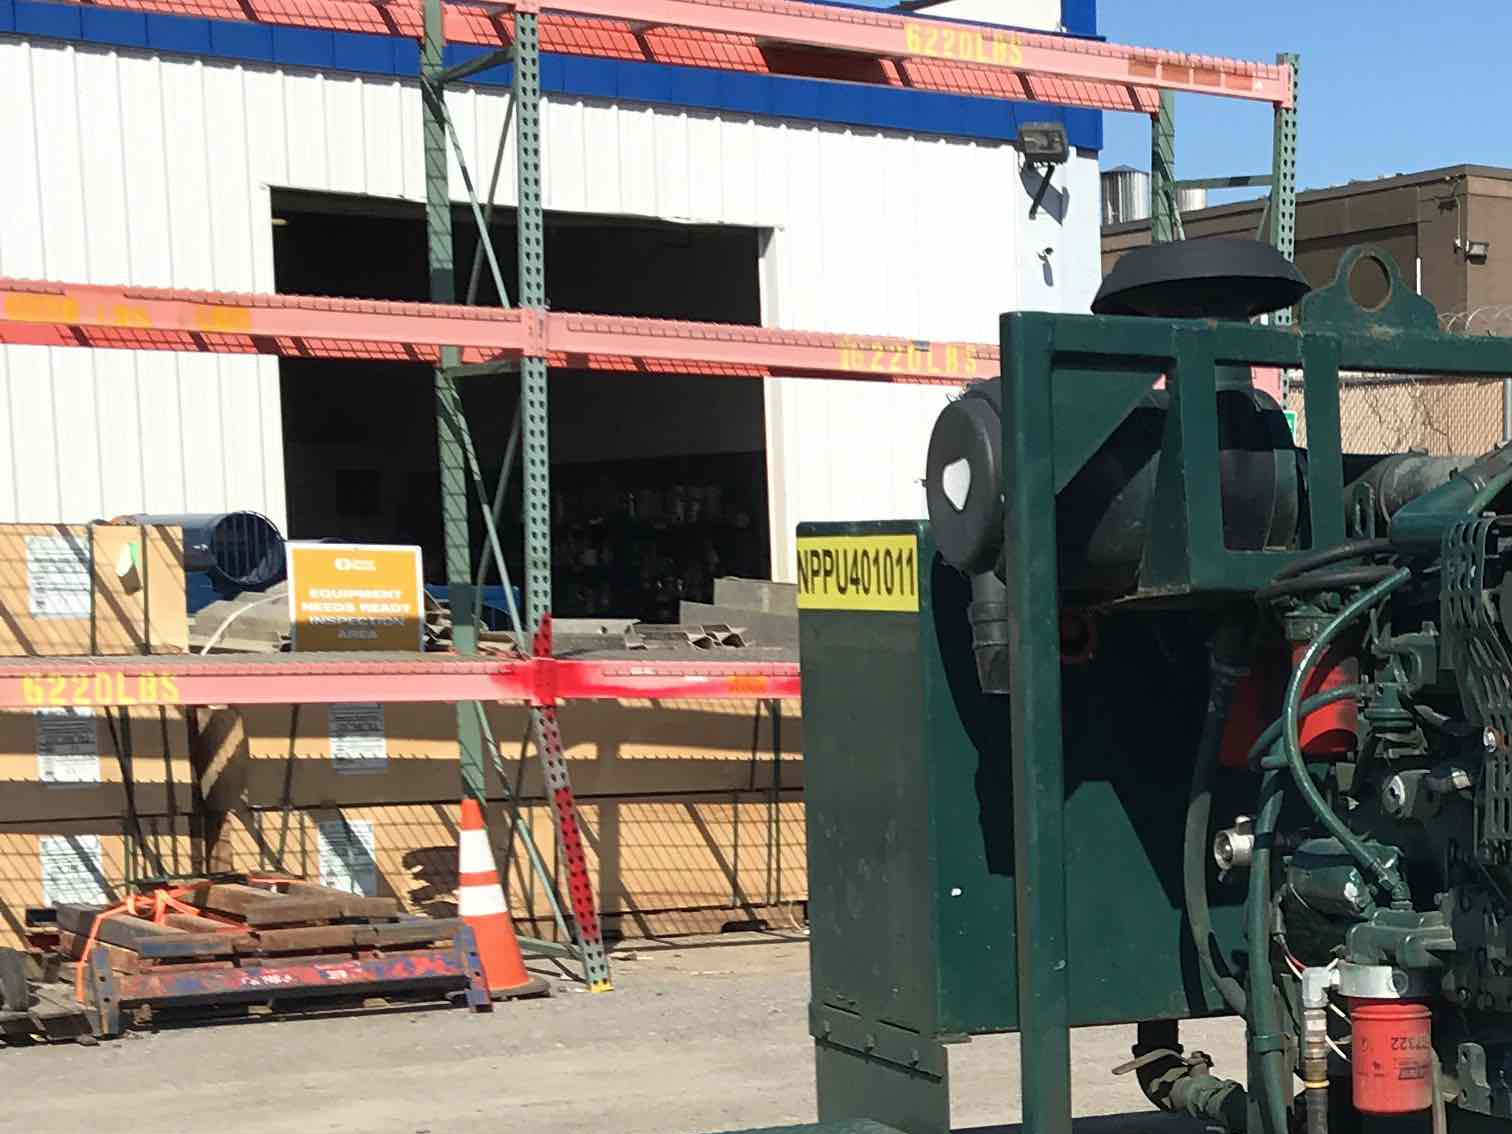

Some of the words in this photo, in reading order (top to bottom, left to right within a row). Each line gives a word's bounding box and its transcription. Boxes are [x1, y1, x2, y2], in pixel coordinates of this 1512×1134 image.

[797, 548, 915, 596] NPPU401011
[309, 588, 403, 598] EQUIPMENT
[301, 602, 356, 612] NEEDS
[360, 603, 411, 613] READY
[309, 615, 405, 626] INSPECTION
[22, 671, 180, 704] 6220LBS
